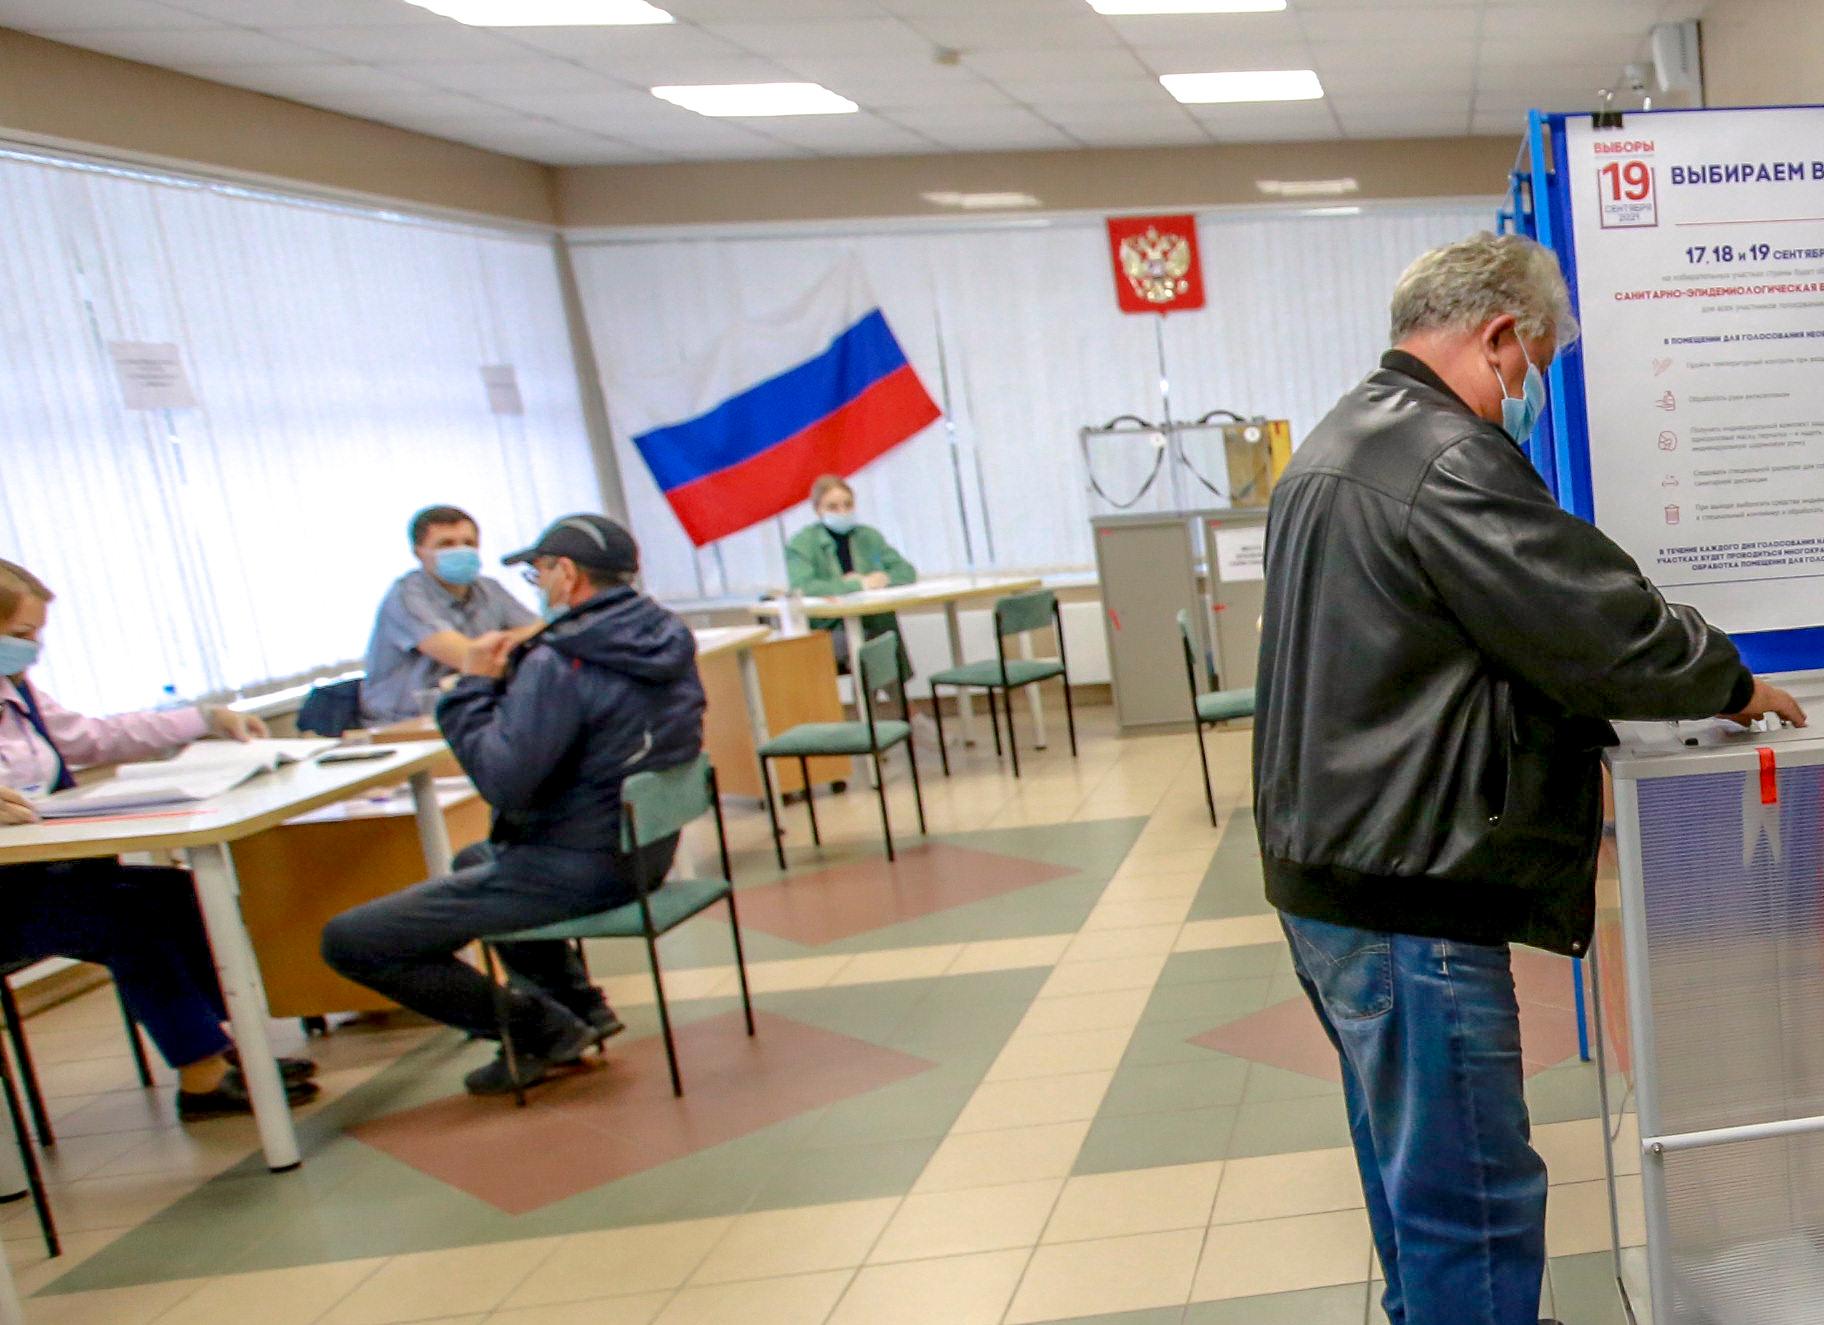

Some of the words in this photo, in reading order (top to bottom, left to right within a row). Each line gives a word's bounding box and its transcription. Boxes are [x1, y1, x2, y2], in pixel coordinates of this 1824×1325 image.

[1593, 141, 1655, 154] ВЫБОРЫ
[1602, 161, 1650, 201] 19
[1671, 162, 1805, 185] ВЫБИРАЕМ
[1713, 245, 1734, 263] 18
[1750, 243, 1770, 261] 19
[1614, 282, 1818, 301] САНИТАРНО-ЭПИДЕМИОЛОГИЧЕСКАЯ
